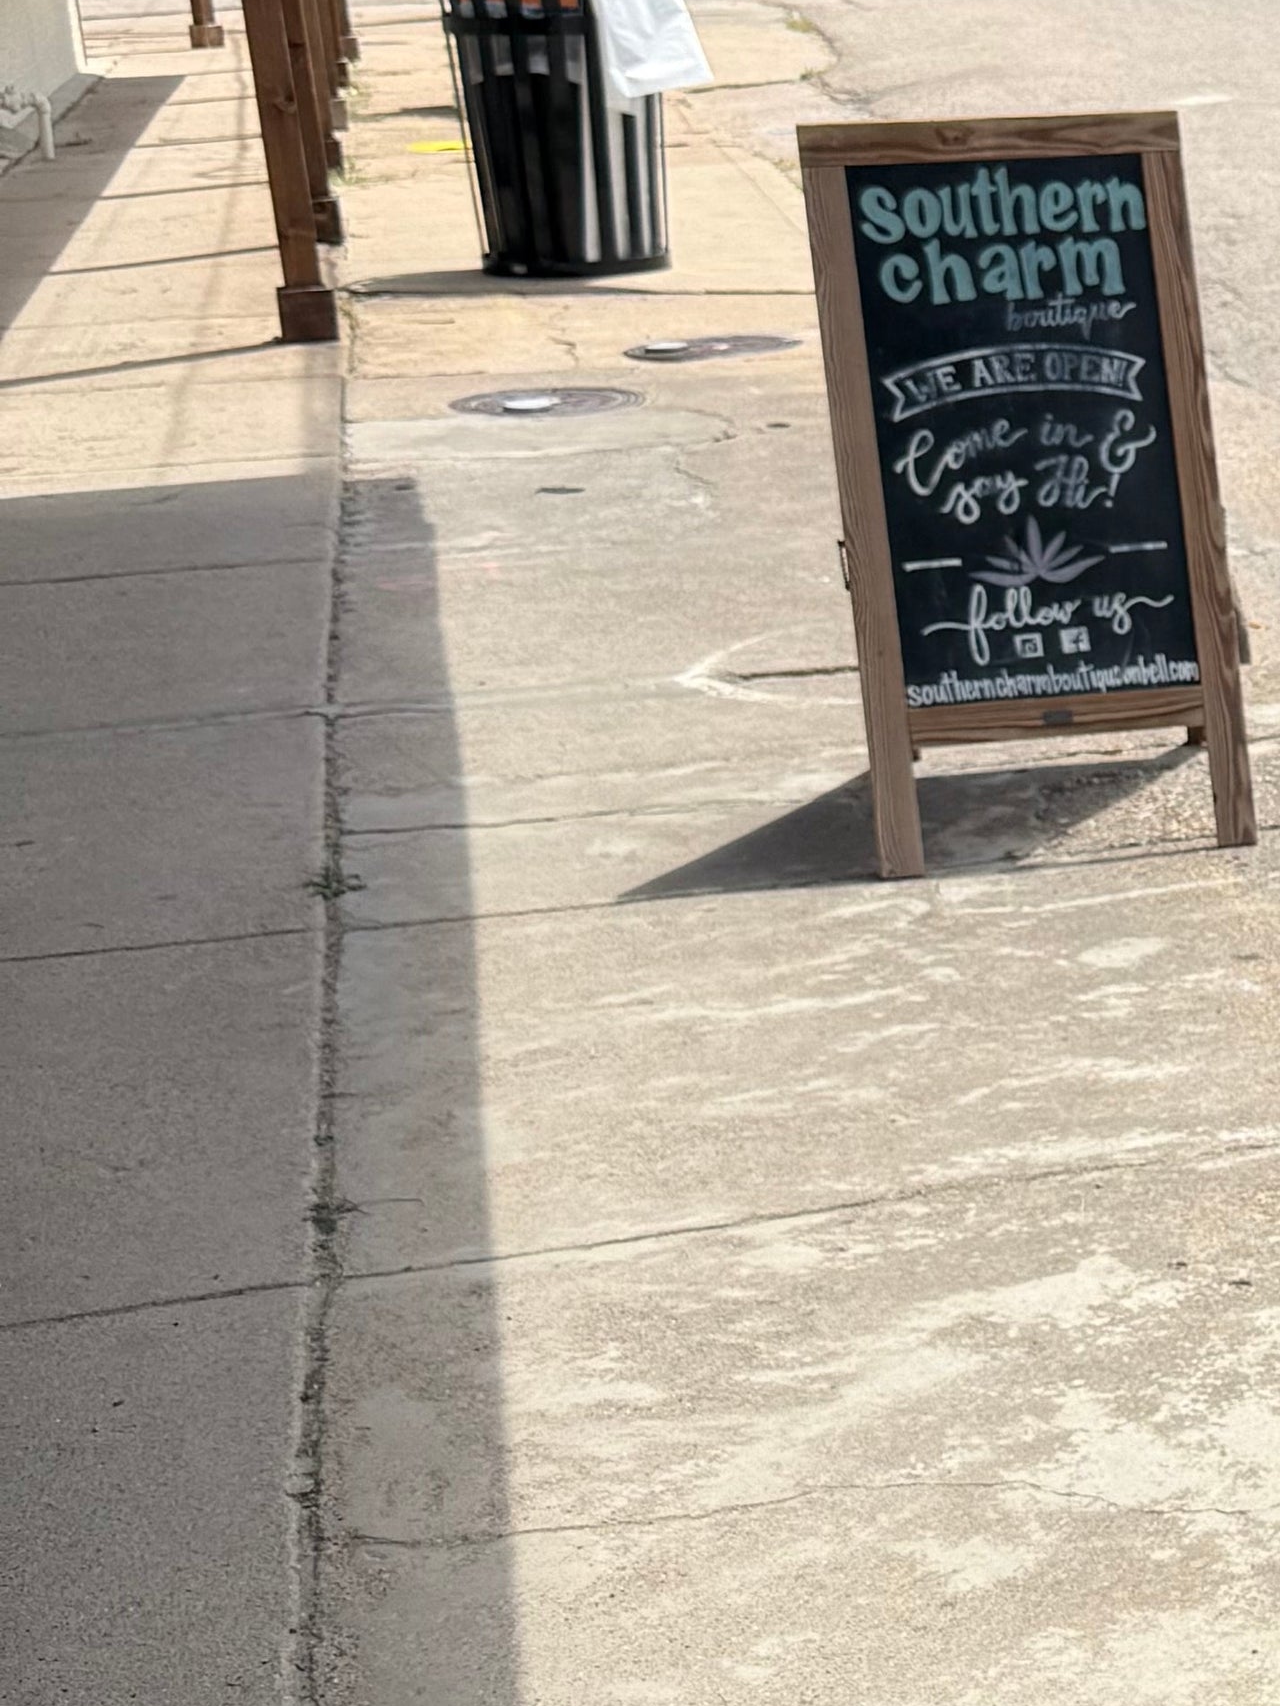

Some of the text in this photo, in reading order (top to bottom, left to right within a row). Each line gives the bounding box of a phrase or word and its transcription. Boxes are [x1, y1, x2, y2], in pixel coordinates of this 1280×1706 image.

[860, 166, 1147, 243] southern
[880, 237, 1126, 305] charm
[1005, 294, 1136, 340] boutique
[903, 352, 1125, 402] WE ARE OPEN!
[893, 409, 1157, 496] Come in &
[939, 454, 1120, 524] say Hi!
[920, 584, 1174, 666] follow us
